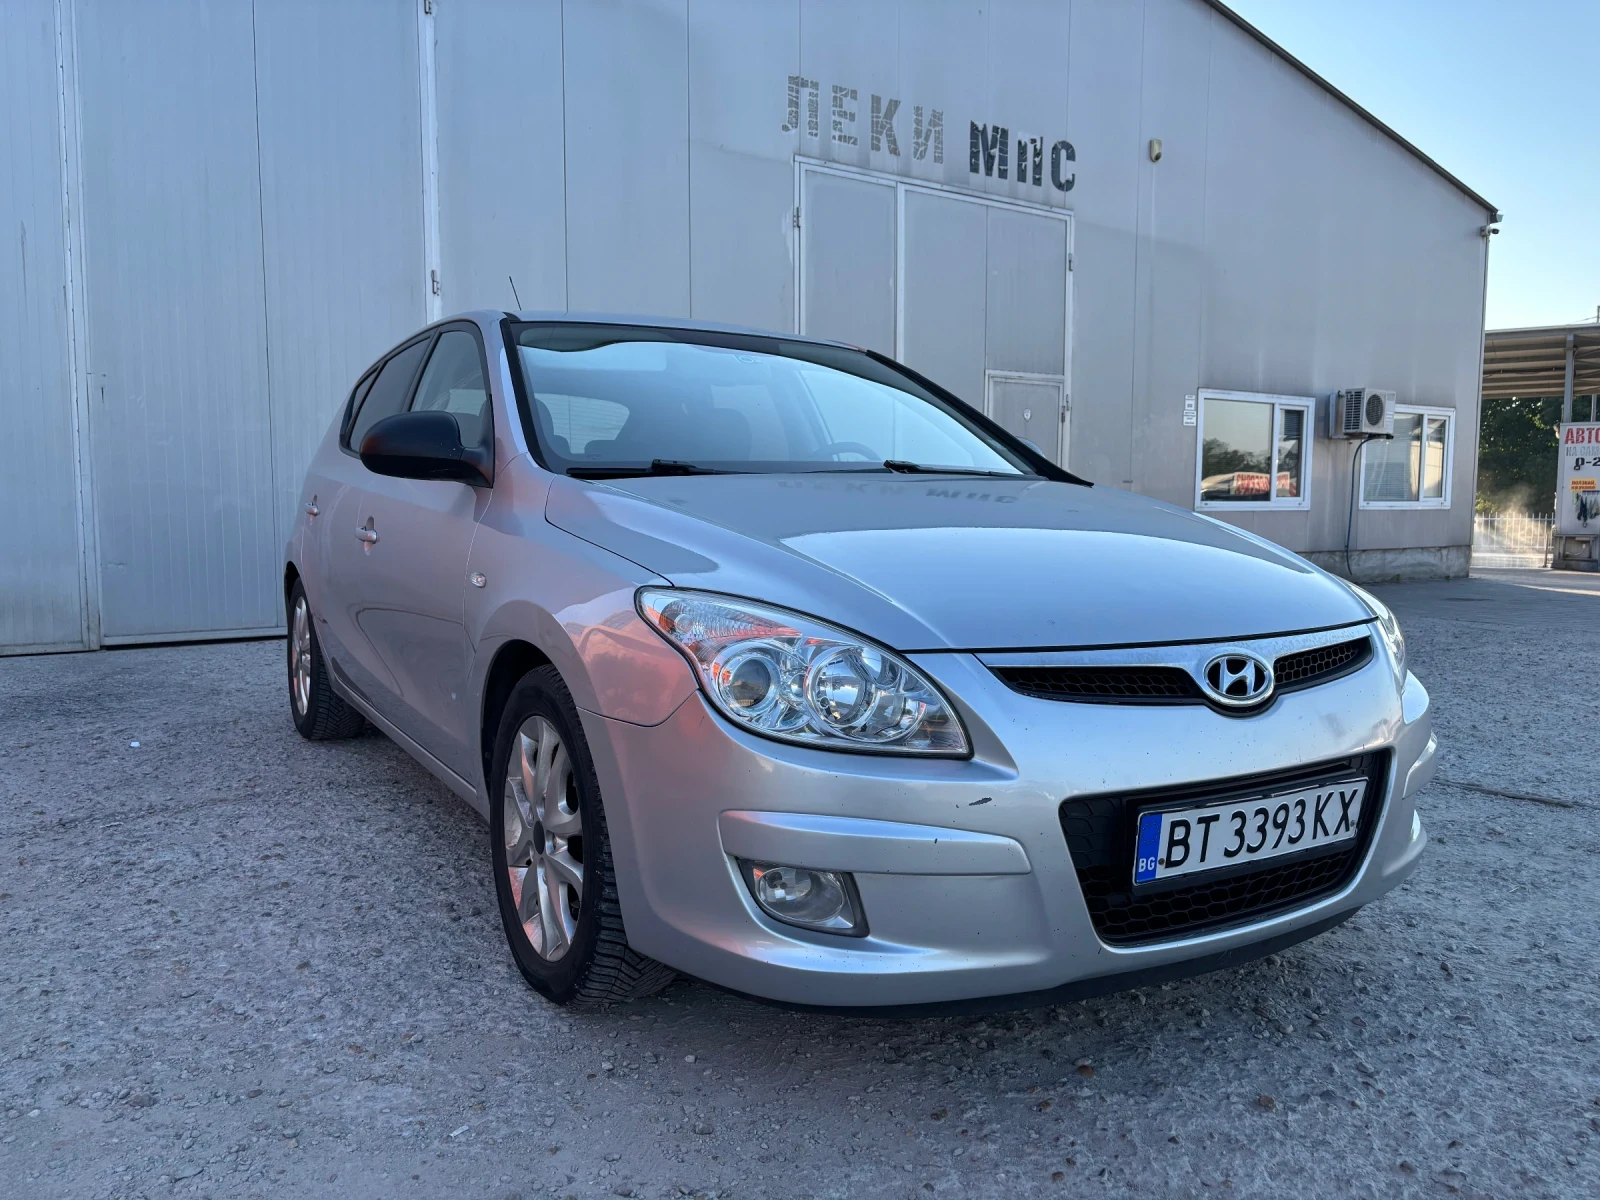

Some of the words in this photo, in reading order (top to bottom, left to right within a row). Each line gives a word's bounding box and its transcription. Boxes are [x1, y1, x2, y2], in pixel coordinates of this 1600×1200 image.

[781, 75, 944, 165] ЛЕКИ
[969, 119, 1076, 192] МПС
[1138, 856, 1156, 873] BG
